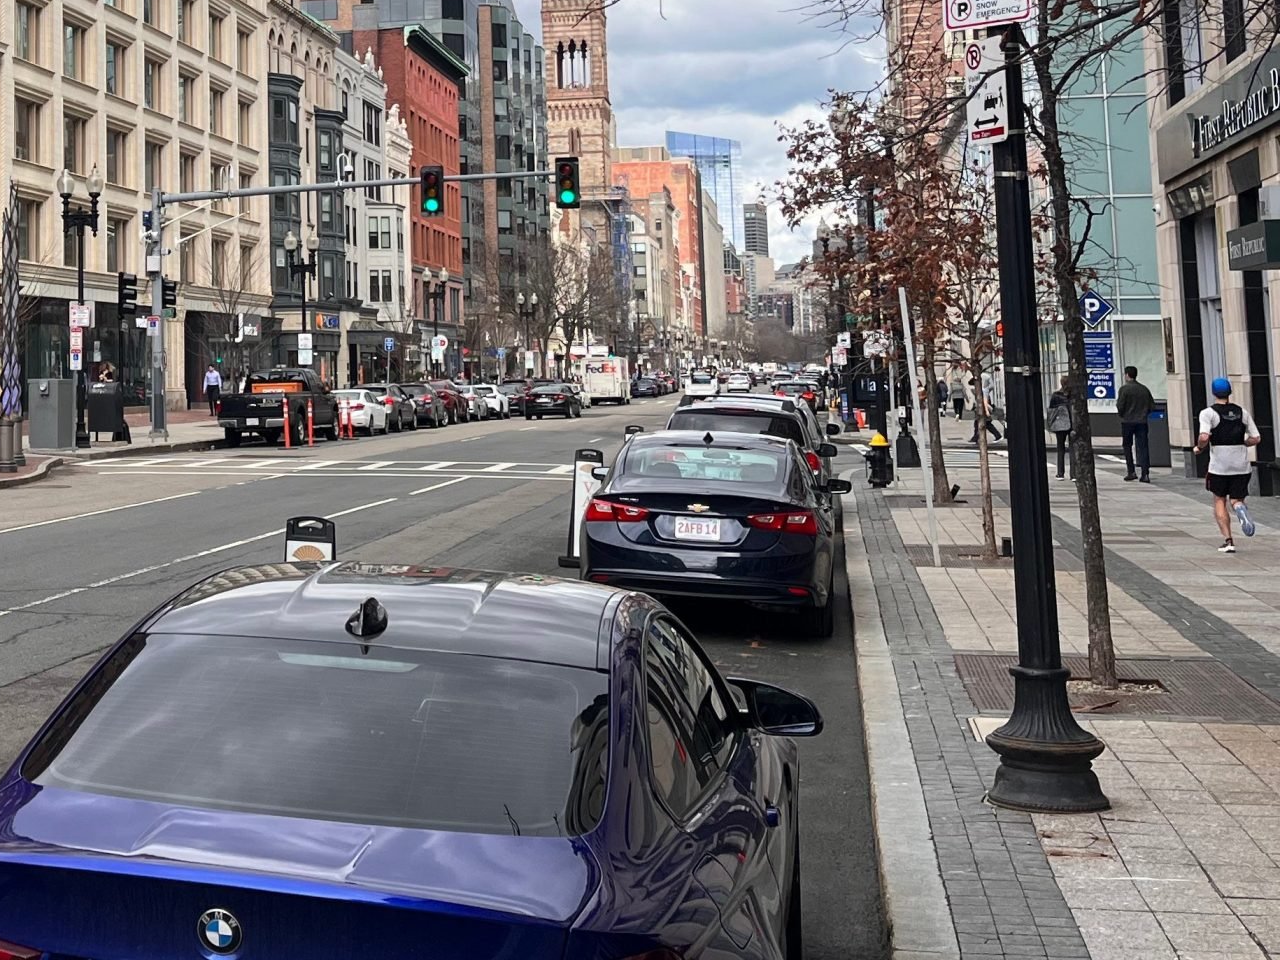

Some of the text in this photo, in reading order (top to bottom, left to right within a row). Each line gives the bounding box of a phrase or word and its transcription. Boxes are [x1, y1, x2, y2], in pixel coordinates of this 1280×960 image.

[976, 1, 998, 10] SNOW
[976, 5, 1021, 19] EMERGENCY
[1198, 115, 1221, 152] FIRST
[1222, 87, 1269, 137] REPUBLIC
[1229, 237, 1265, 259] FIRST REPUBLIC
[585, 363, 617, 374] FedEx
[677, 522, 703, 535] 2AFB
[201, 910, 238, 928] BMW
